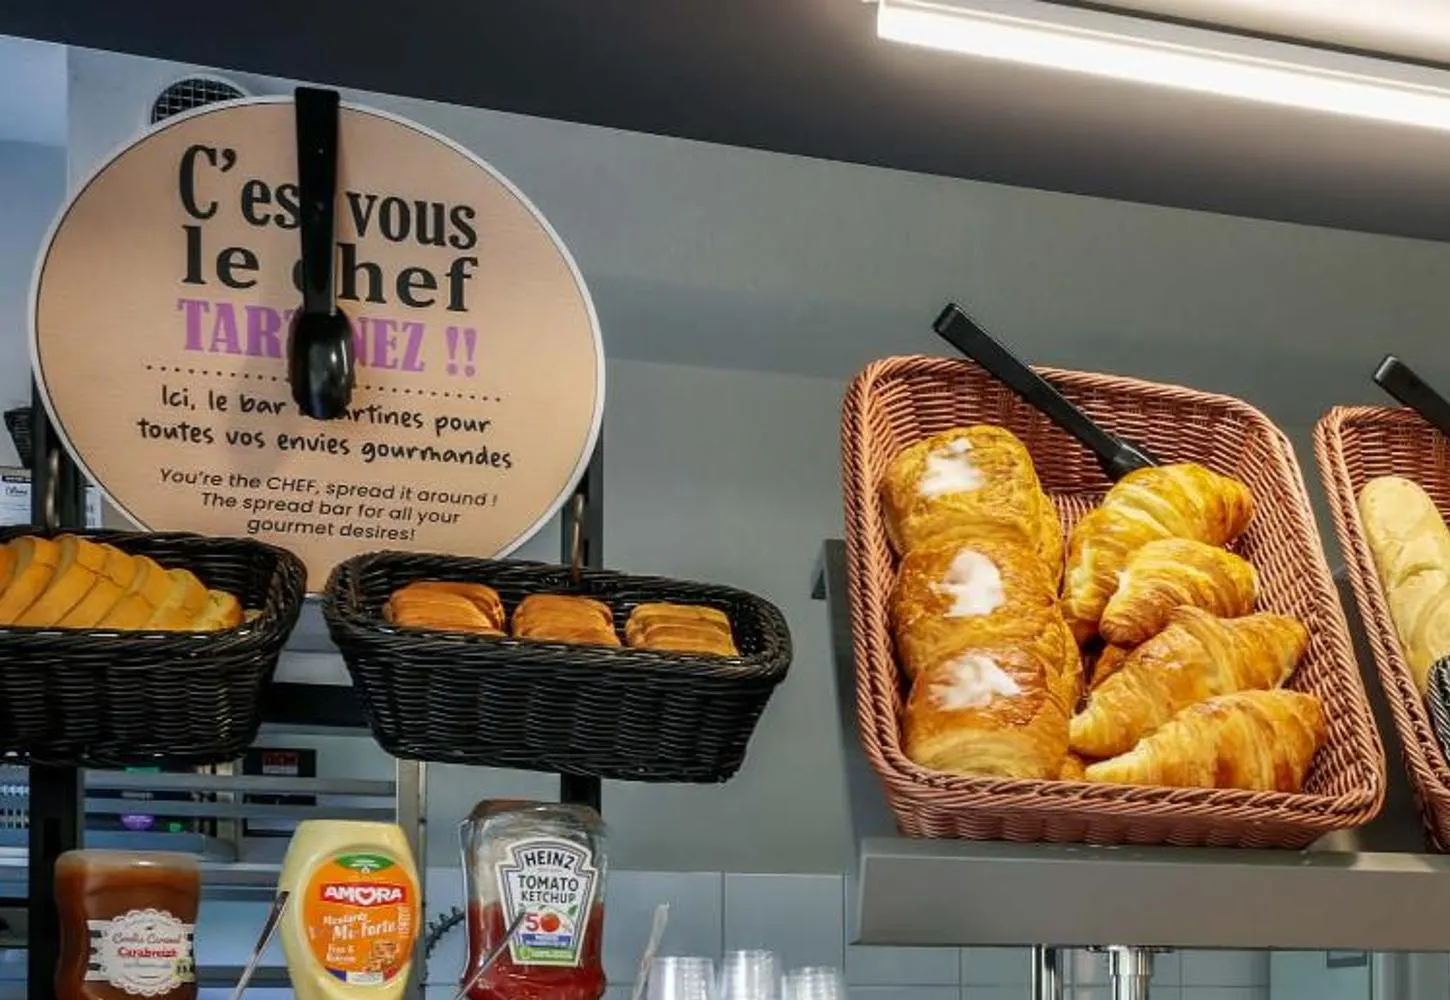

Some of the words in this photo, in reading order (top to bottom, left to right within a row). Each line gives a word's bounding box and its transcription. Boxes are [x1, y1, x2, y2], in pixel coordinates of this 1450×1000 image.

[178, 143, 301, 230] C'es
[345, 190, 478, 250] vous
[181, 224, 260, 290] le
[176, 297, 426, 373] TARNEZ
[445, 325, 478, 378] !!
[161, 384, 196, 411] Ici,
[208, 388, 229, 412] le
[239, 393, 288, 416] bar
[434, 415, 492, 437] pour
[136, 417, 215, 444] toutes
[225, 430, 266, 449] vos
[276, 432, 351, 456] envies
[360, 442, 513, 469] gourmandes
[159, 467, 224, 487] You're
[229, 473, 262, 489] the
[265, 475, 321, 495] CHEF,
[325, 482, 396, 500] spread
[399, 486, 412, 501] it
[416, 488, 489, 507] around
[201, 491, 239, 508] The
[242, 496, 314, 515] spread
[318, 500, 353, 517] bar
[358, 503, 384, 519] for
[388, 506, 414, 522] all
[416, 510, 463, 527] your
[246, 518, 334, 537] gourmet
[339, 522, 417, 542] desires!
[523, 849, 577, 870] HEINZ
[323, 885, 403, 906] AMORA
[517, 875, 580, 893] TOMATO
[520, 889, 577, 905] KETCHUP
